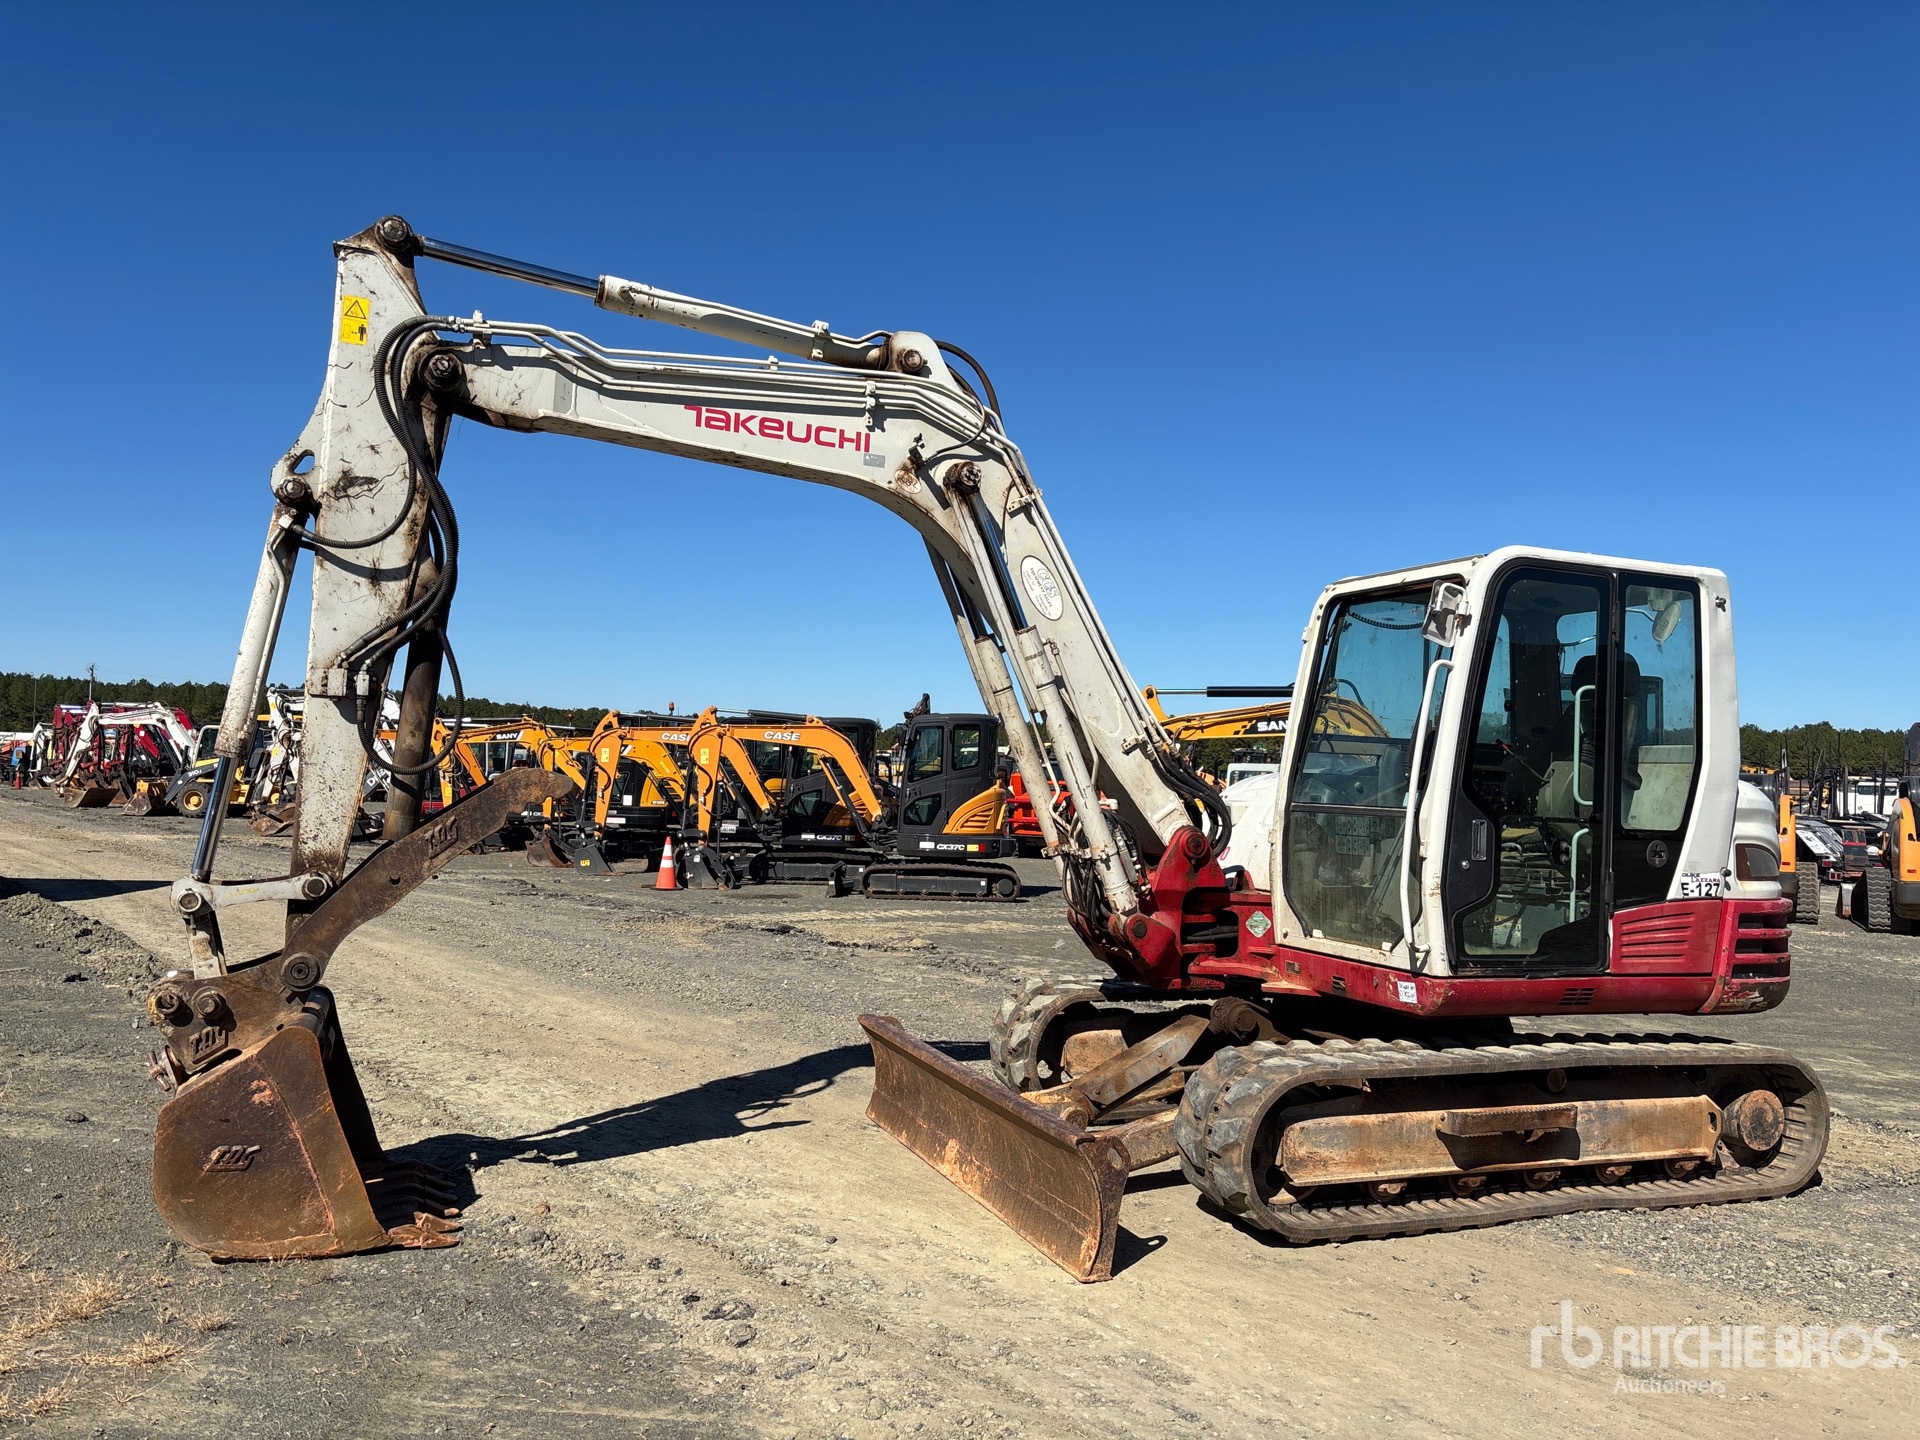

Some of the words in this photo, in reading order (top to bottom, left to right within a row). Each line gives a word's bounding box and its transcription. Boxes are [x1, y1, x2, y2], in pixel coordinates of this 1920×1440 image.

[684, 404, 871, 453] TAKEUCHI
[1256, 720, 1288, 731] SAN
[763, 731, 801, 741] CASE
[936, 842, 965, 851] CX37C
[1680, 882, 1720, 897] E-127
